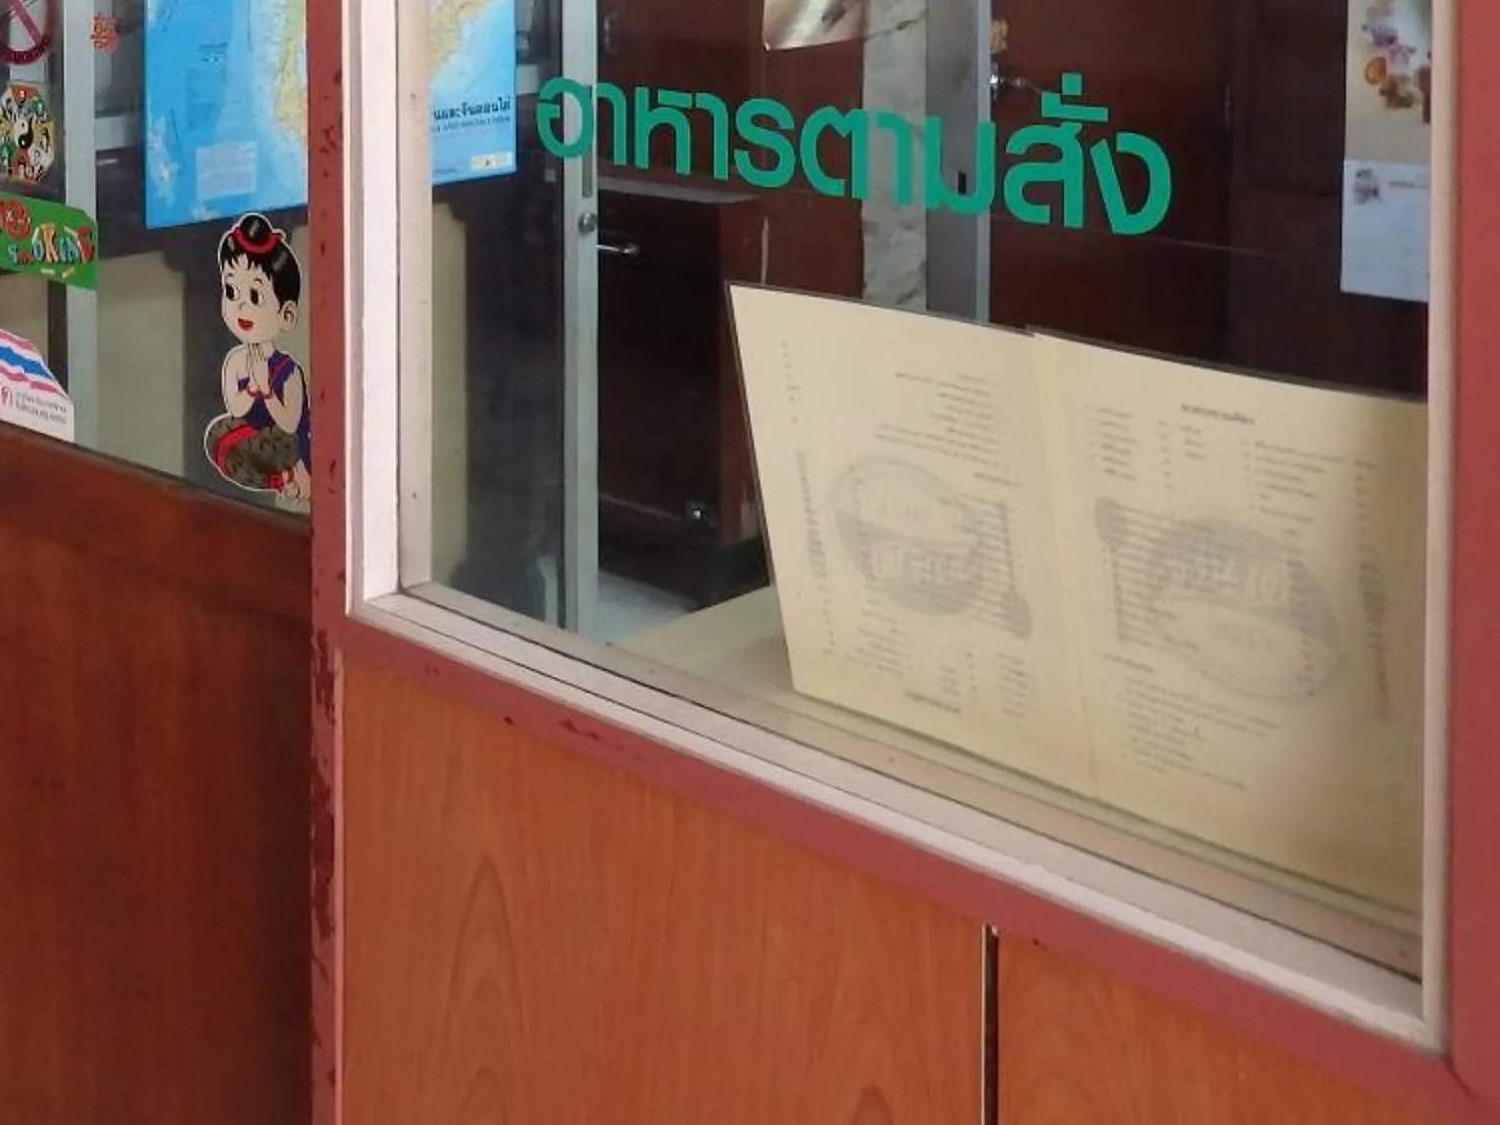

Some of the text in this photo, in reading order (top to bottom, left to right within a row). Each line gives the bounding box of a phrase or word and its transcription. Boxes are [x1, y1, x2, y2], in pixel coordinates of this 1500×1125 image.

[536, 73, 1172, 236] อาหารตามสั่ง
